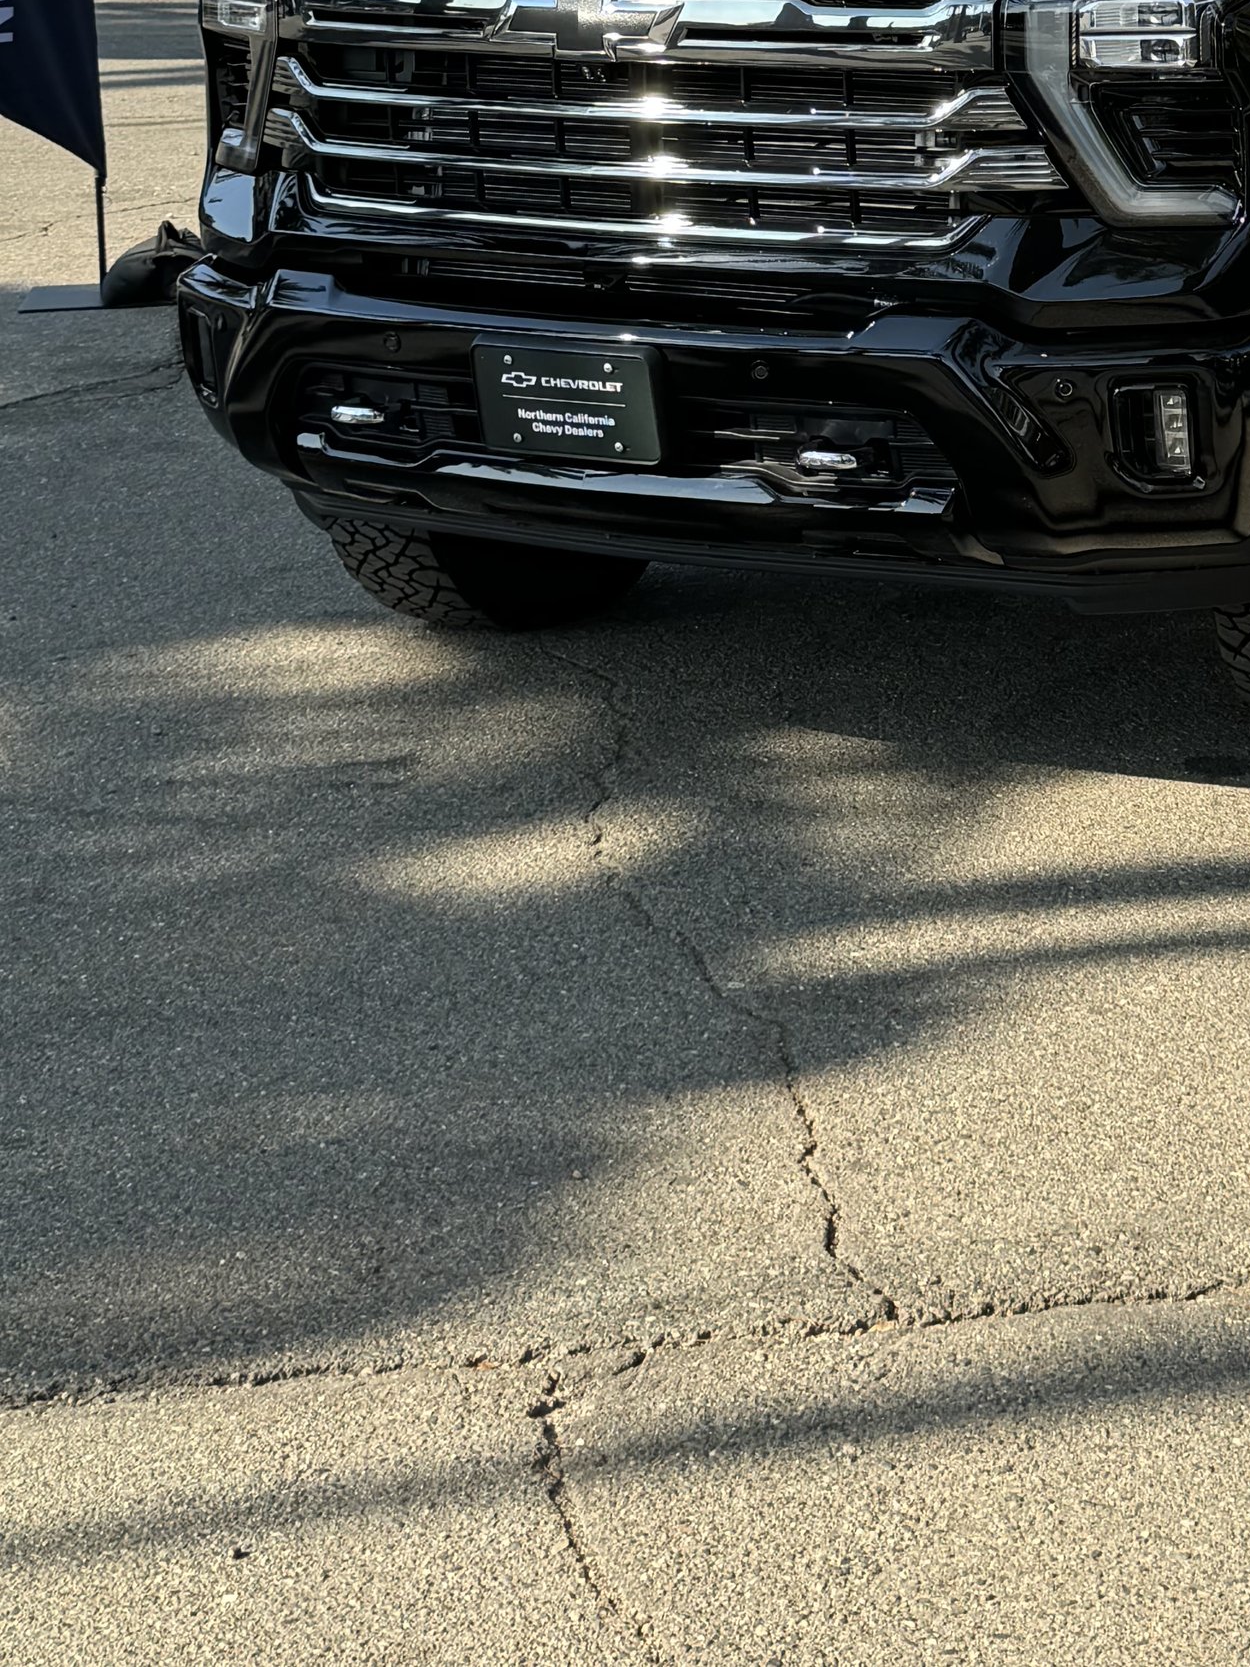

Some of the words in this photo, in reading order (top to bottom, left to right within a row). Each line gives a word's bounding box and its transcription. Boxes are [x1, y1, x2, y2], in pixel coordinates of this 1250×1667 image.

[540, 376, 624, 393] CHEVROLET
[517, 407, 564, 423] Northern
[564, 412, 616, 427] California
[532, 421, 563, 437] Chevy
[564, 425, 604, 438] Dealers
